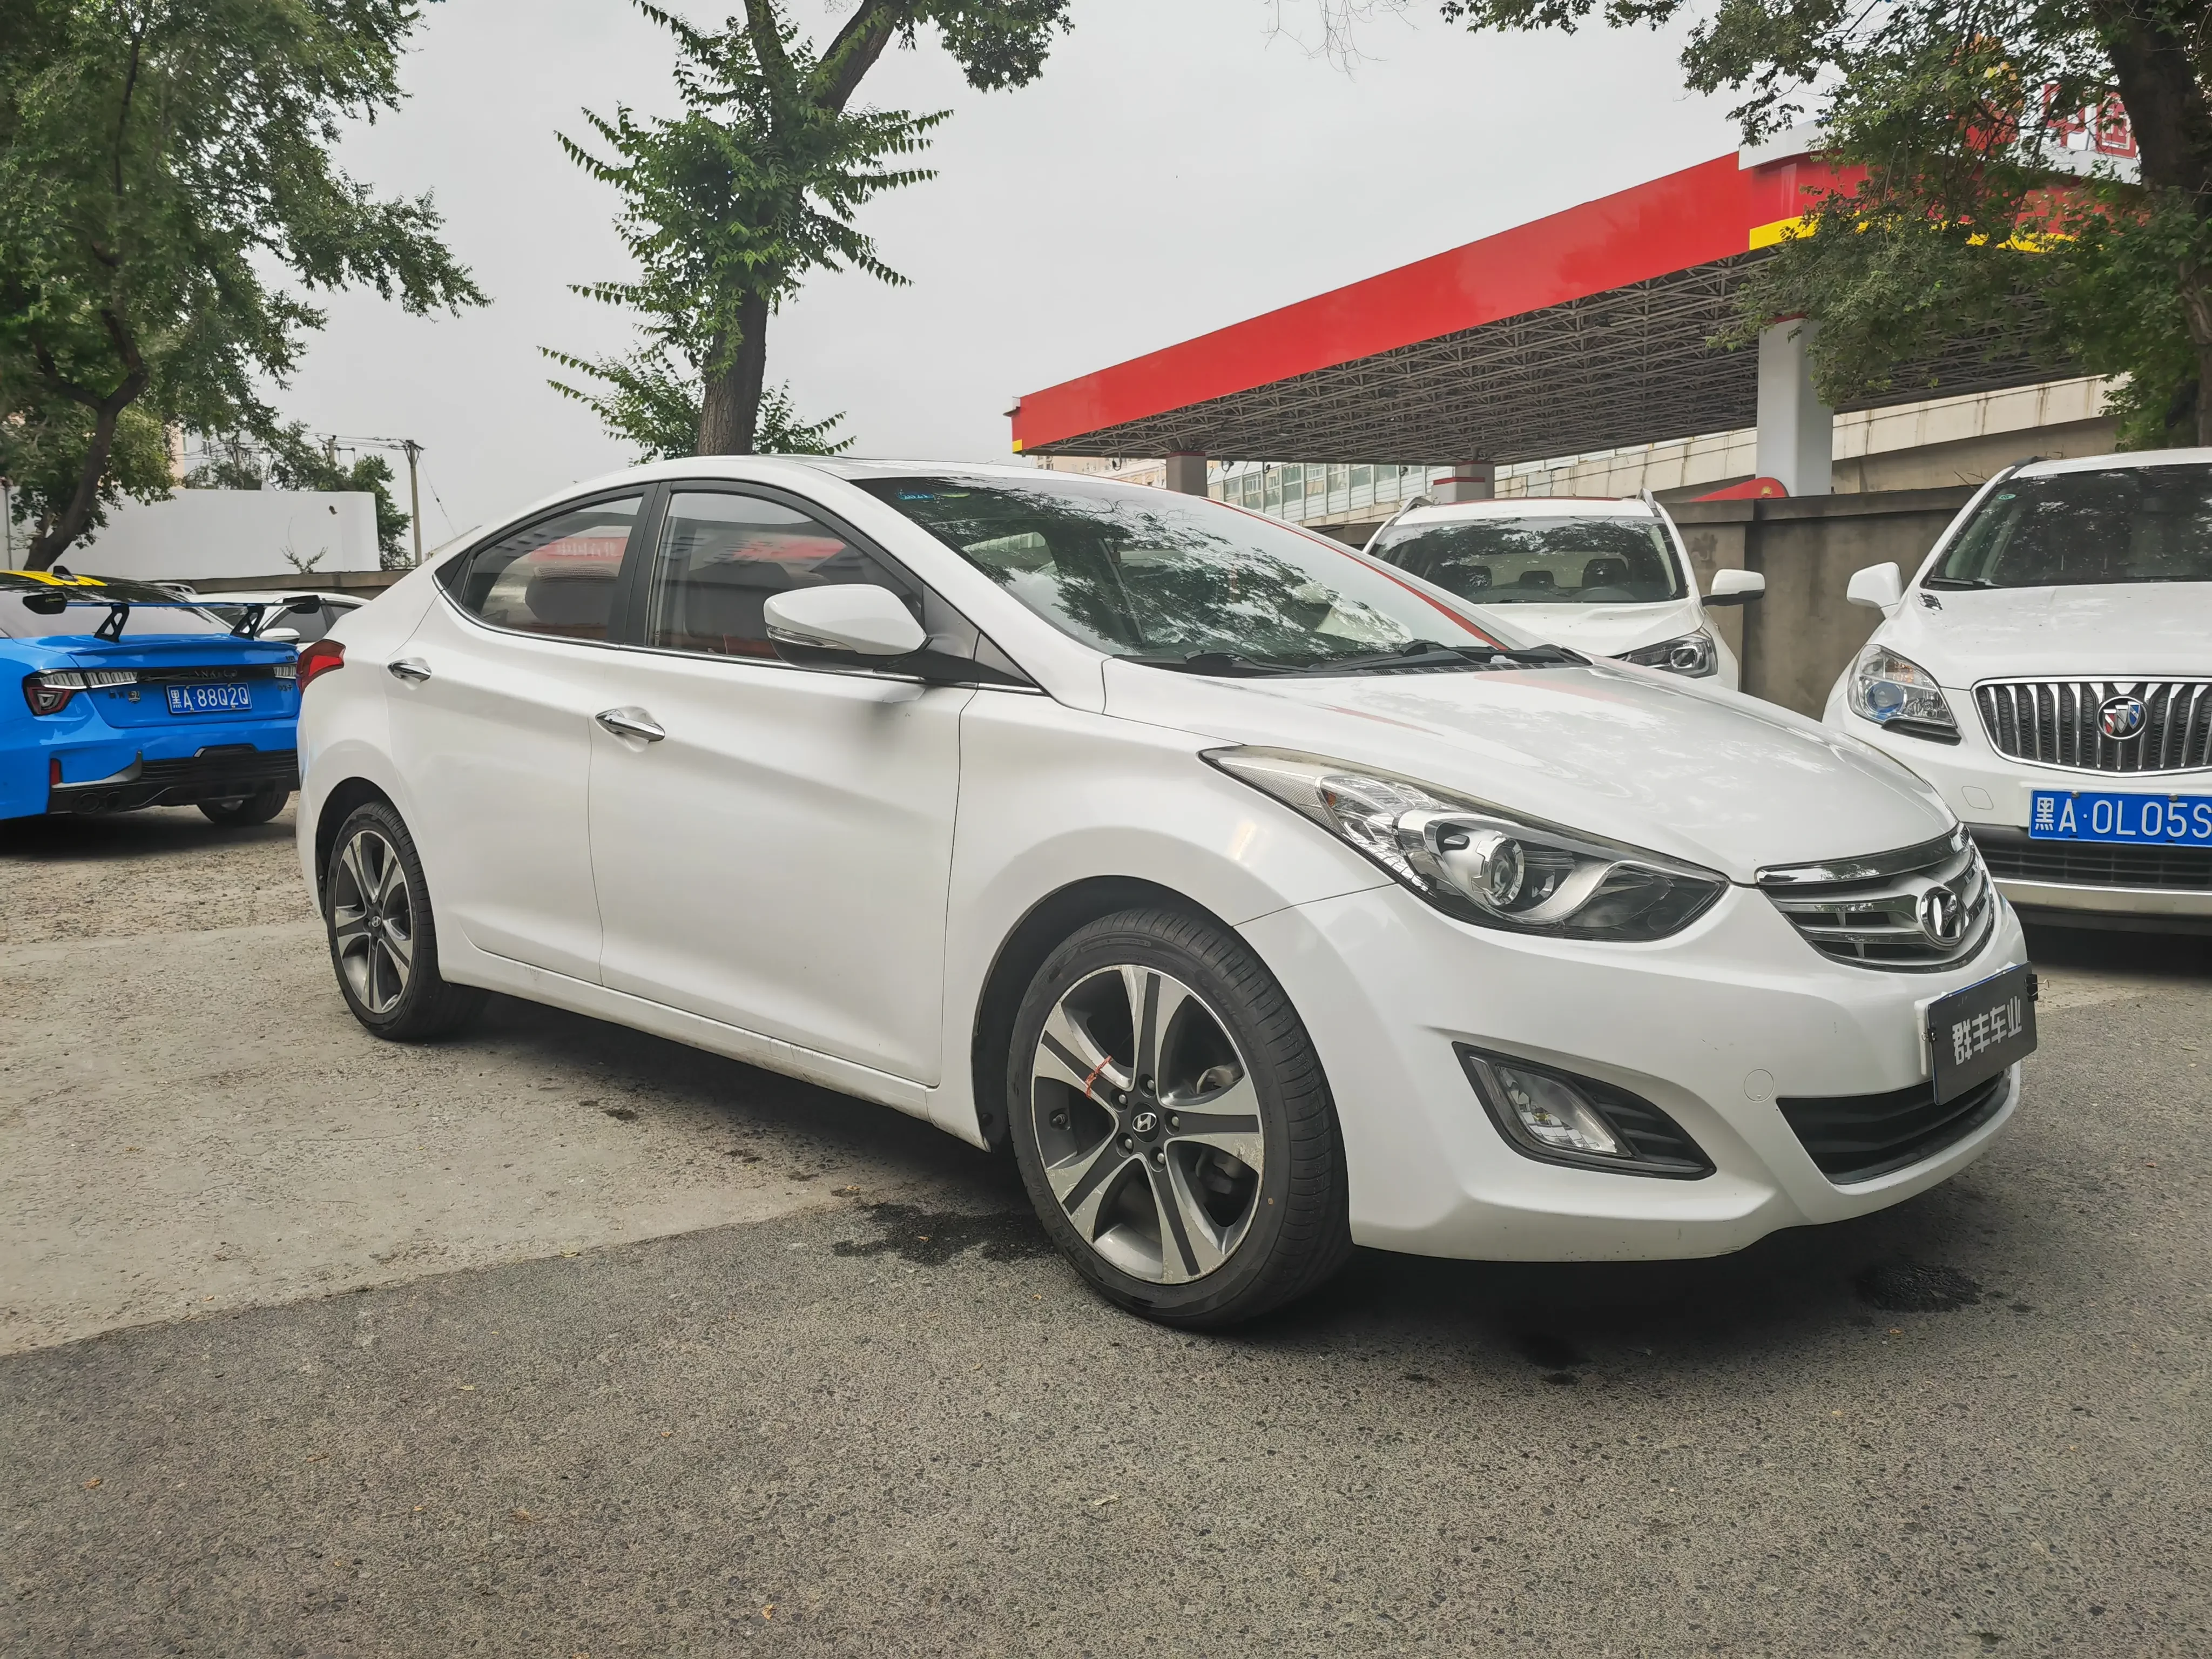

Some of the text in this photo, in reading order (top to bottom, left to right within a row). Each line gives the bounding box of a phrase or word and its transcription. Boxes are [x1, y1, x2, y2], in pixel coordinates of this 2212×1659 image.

[171, 686, 249, 709] 黑A·88Q2Q
[2035, 797, 2212, 838] 黑A·0L05S
[1952, 995, 2022, 1065] 群丰车业
